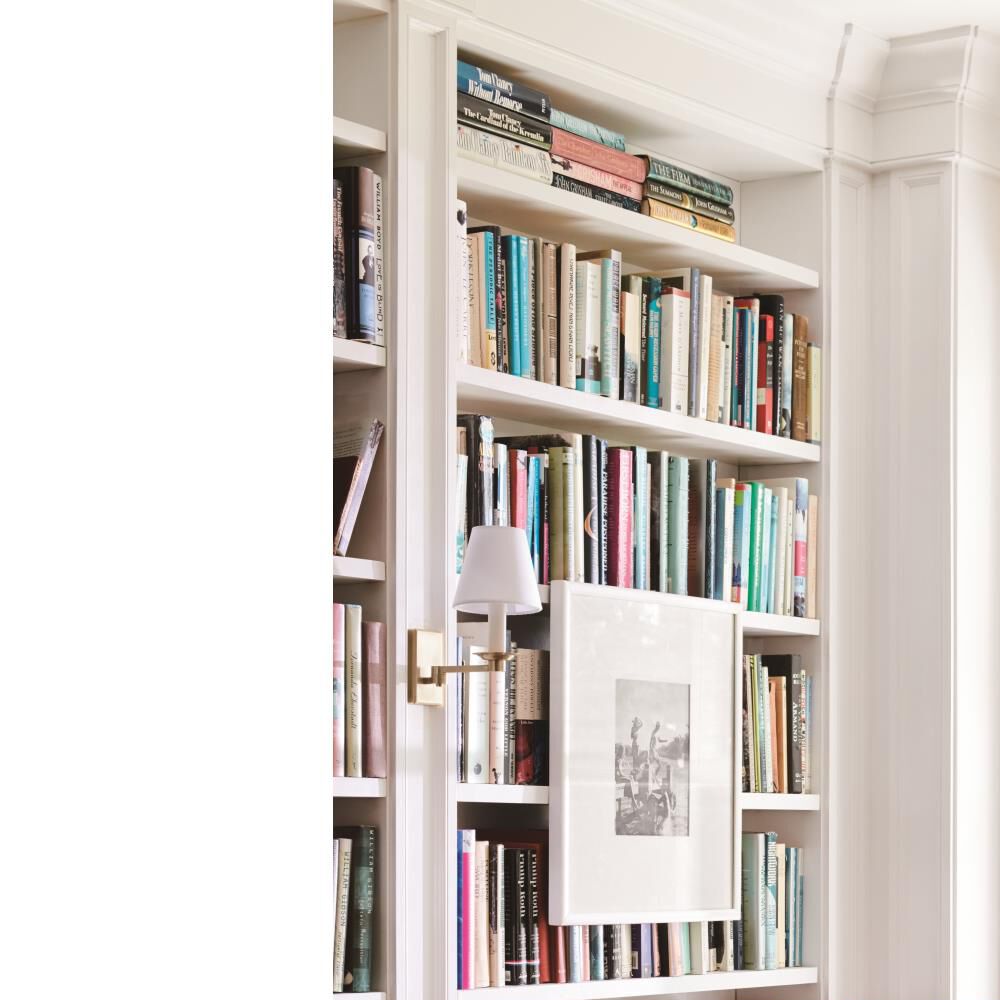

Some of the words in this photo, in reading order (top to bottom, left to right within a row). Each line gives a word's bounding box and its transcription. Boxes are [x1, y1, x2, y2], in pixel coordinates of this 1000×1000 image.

[468, 78, 494, 102] Without
[494, 89, 523, 111] Remorse
[476, 67, 492, 84] Tom
[490, 72, 513, 96] Clancy
[464, 107, 476, 118] The
[476, 112, 503, 127] Cardinal
[508, 124, 518, 133] the
[519, 127, 544, 142] Kremlin
[488, 108, 501, 120] Tom
[500, 113, 520, 128] Clancy
[556, 174, 570, 192] JOHN
[570, 182, 592, 198] GRISHAM
[652, 162, 671, 178] THE
[671, 168, 691, 185] FIRM
[650, 184, 660, 192] THE
[660, 185, 682, 200] SUMMONS
[696, 198, 707, 208] JOHN
[708, 202, 728, 214] GRISHAM
[768, 841, 777, 886] NIGHTWORK
